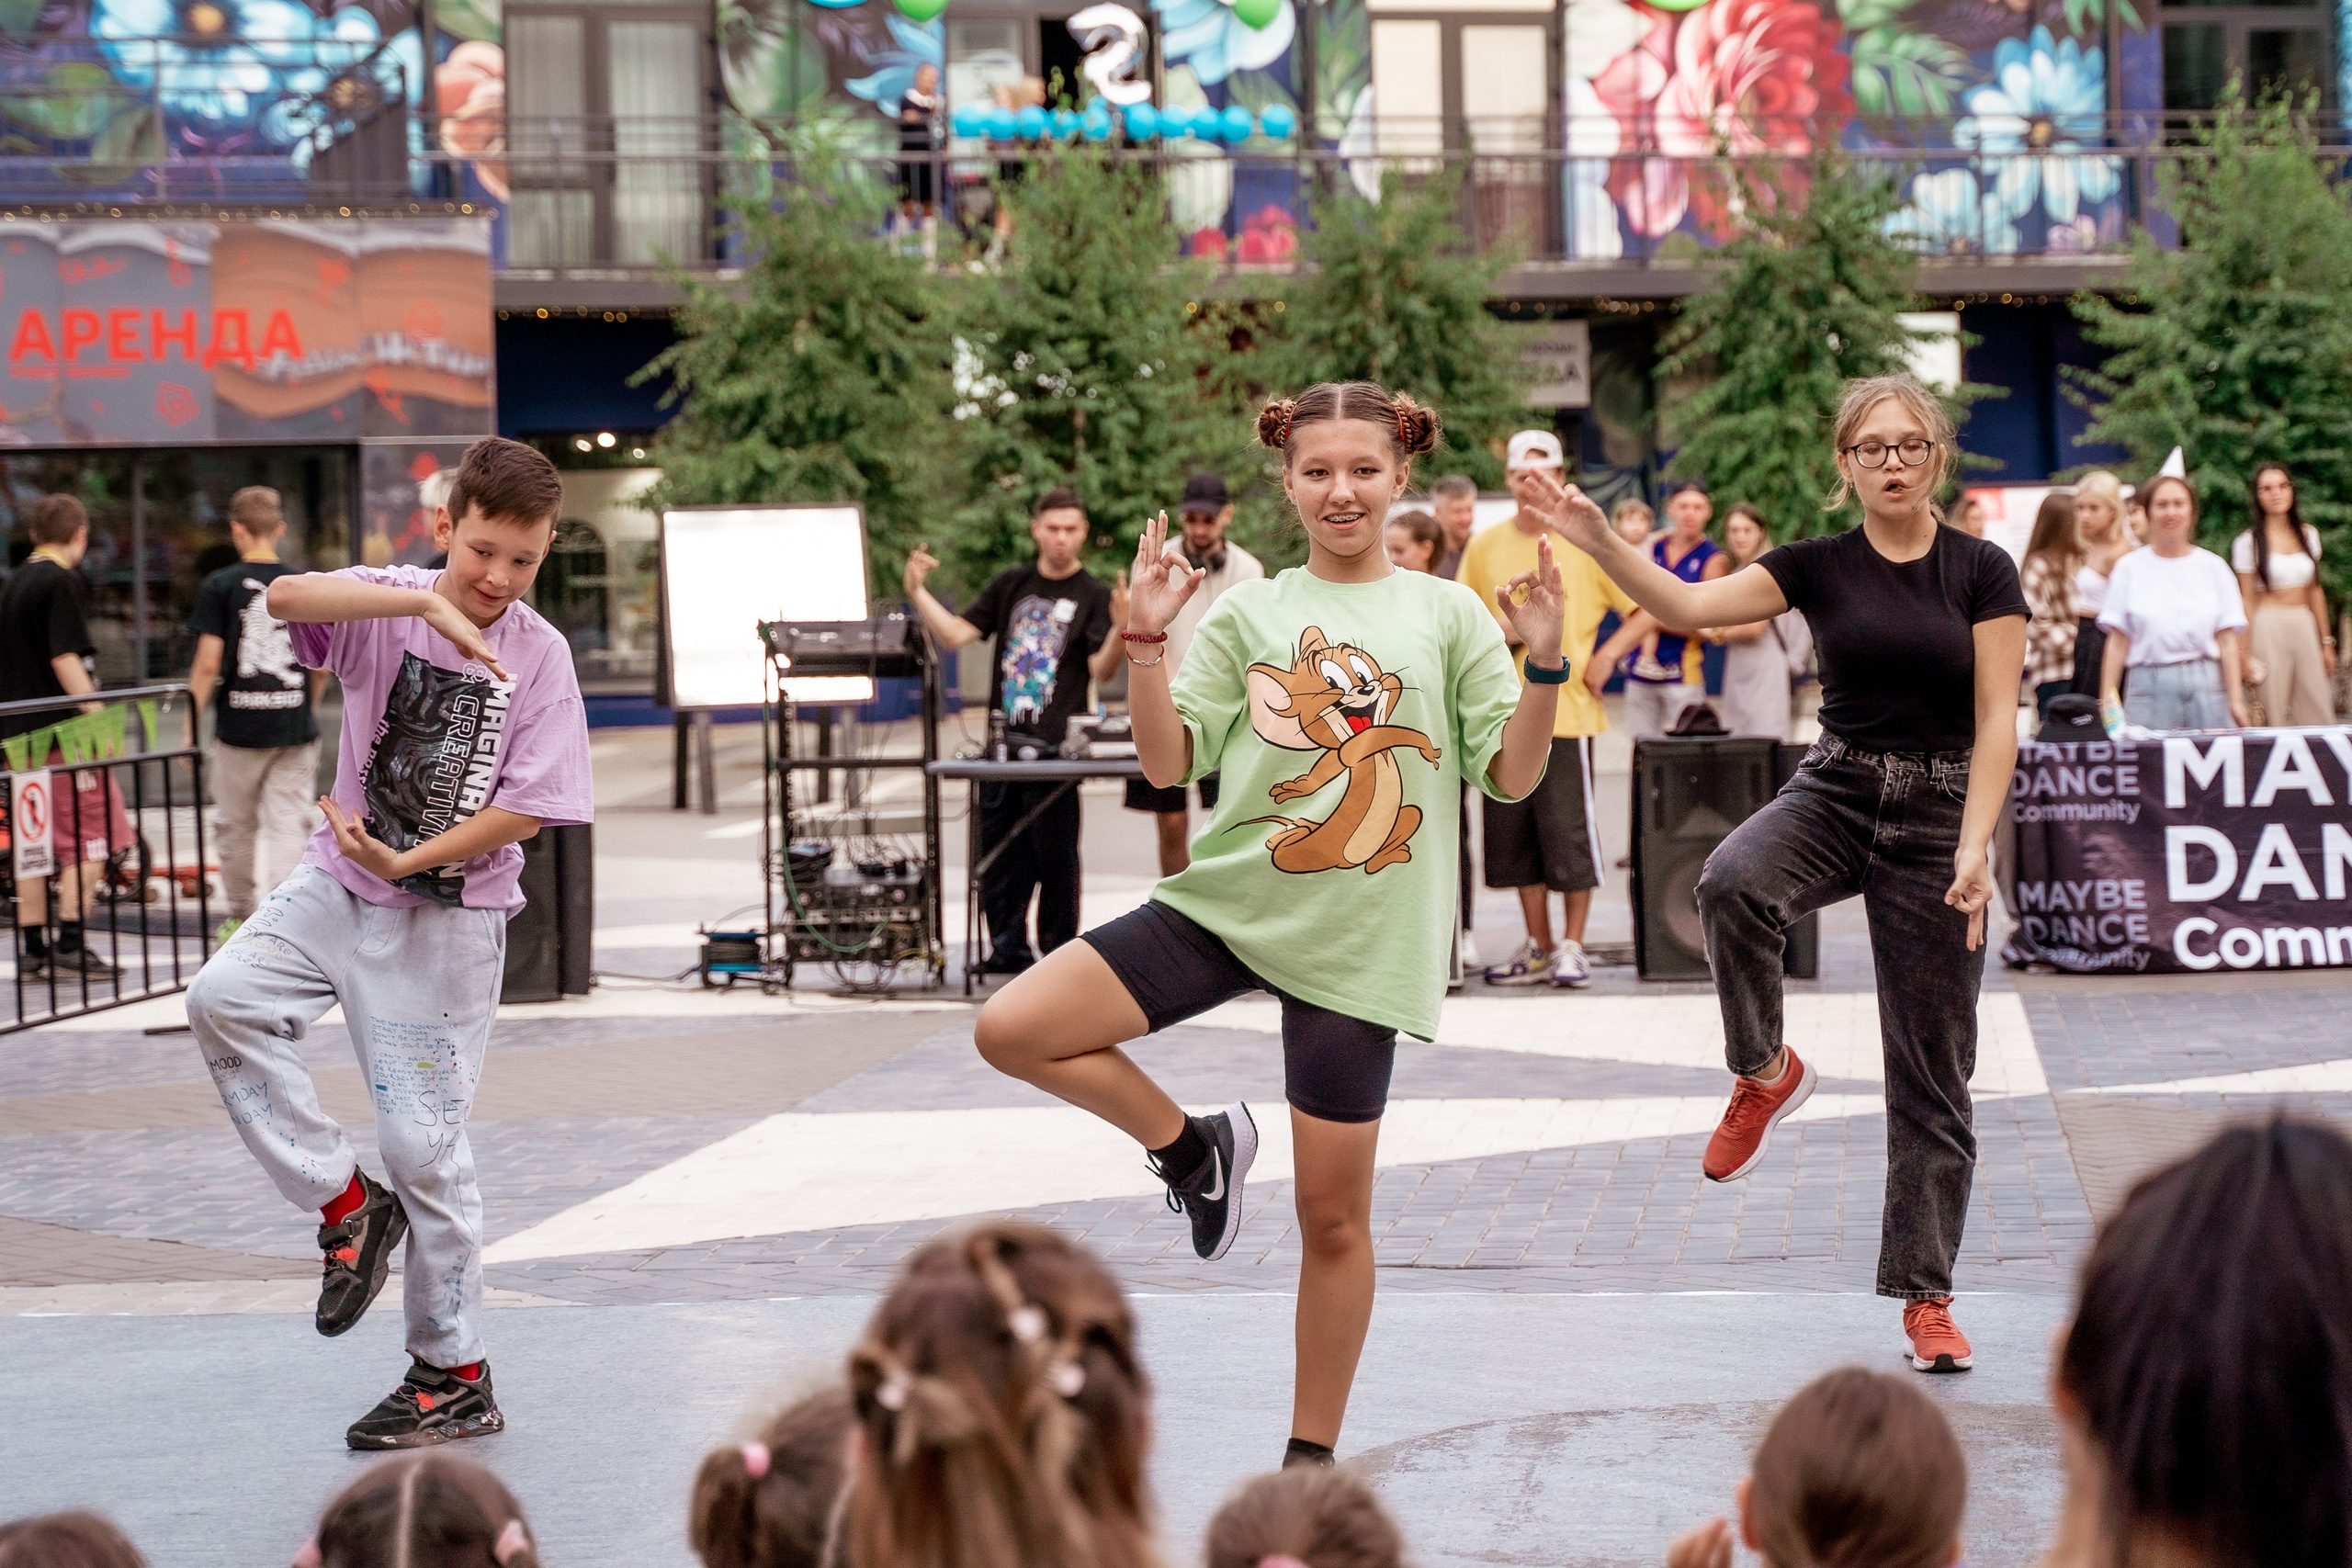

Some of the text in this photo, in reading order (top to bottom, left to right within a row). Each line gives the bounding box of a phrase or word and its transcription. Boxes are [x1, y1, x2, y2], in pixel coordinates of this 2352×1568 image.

[8, 306, 306, 371] АРЕНДА
[459, 662, 488, 684] &
[372, 718, 390, 746] the
[2010, 764, 2142, 798] DANCE
[2012, 798, 2143, 825] Community
[2018, 878, 2148, 913] MAYBE
[2023, 913, 2152, 945] DANCE
[266, 937, 293, 956] ARE
[369, 1016, 386, 1026] THE
[209, 1055, 243, 1073] MOOD
